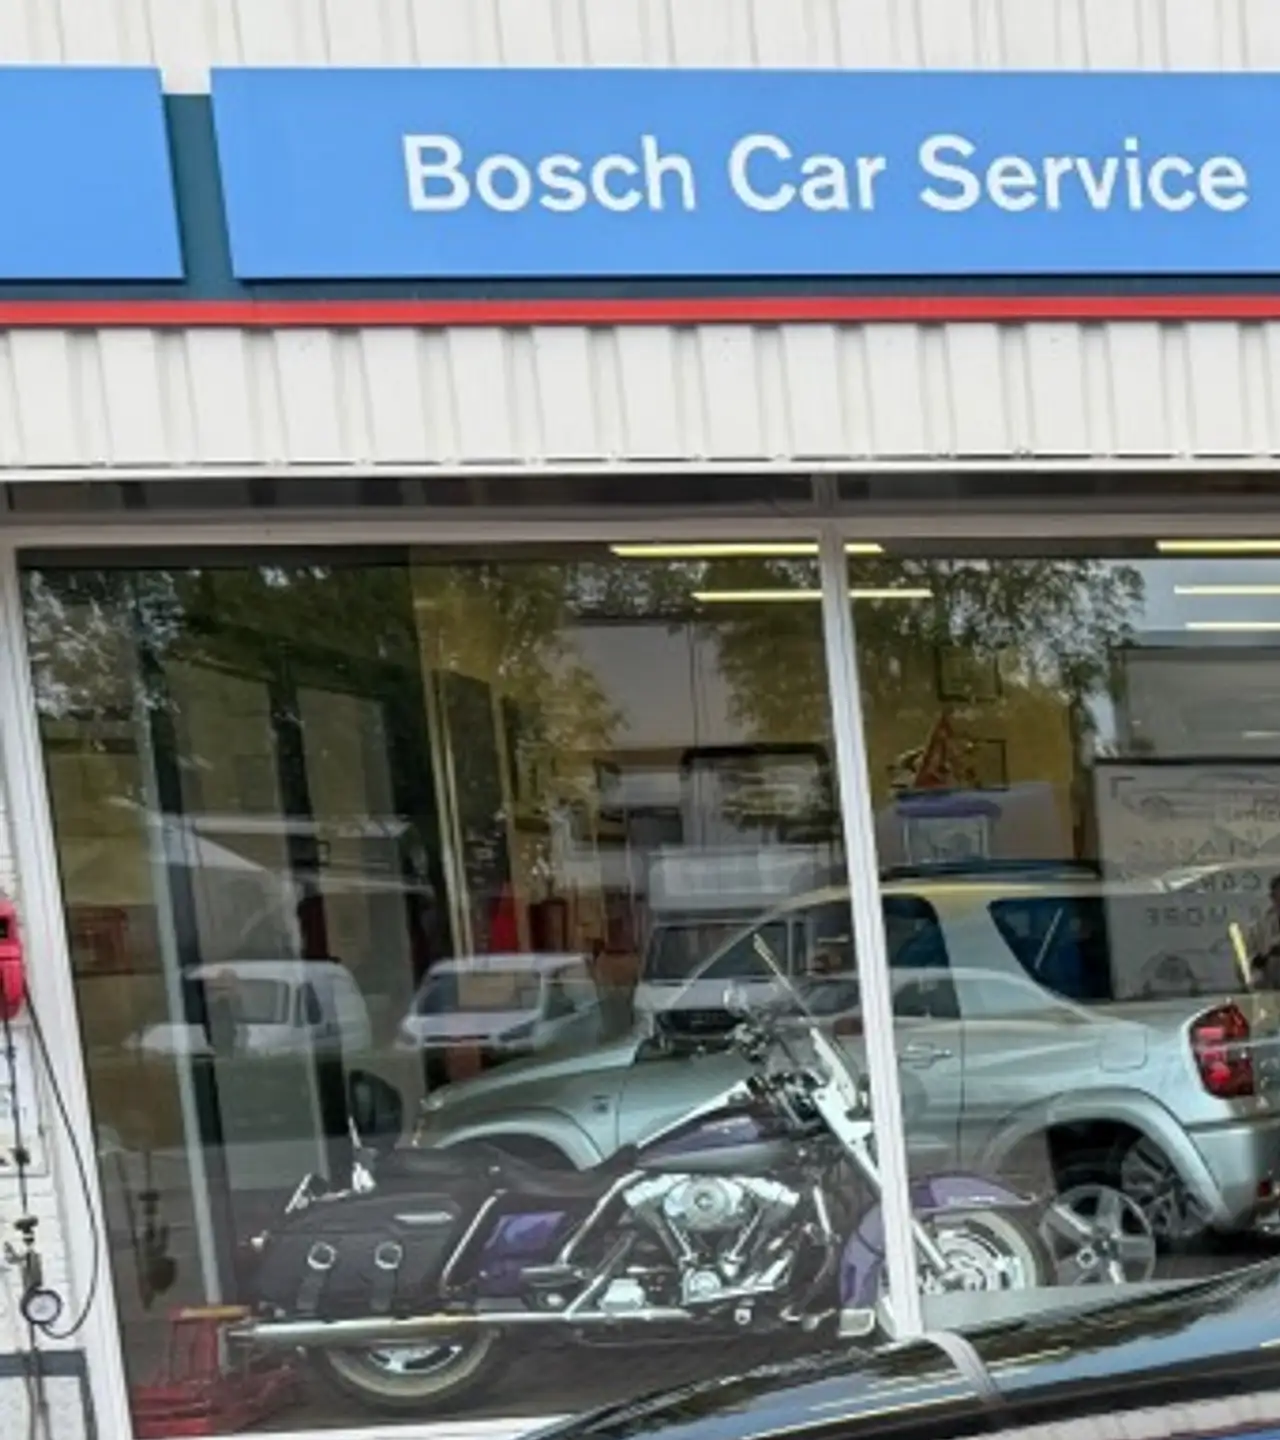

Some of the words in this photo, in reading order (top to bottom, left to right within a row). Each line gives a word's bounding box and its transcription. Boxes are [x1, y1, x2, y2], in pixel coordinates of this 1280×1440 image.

[402, 133, 696, 212] Bosch
[728, 133, 887, 212] Car
[919, 134, 1249, 212] Service
